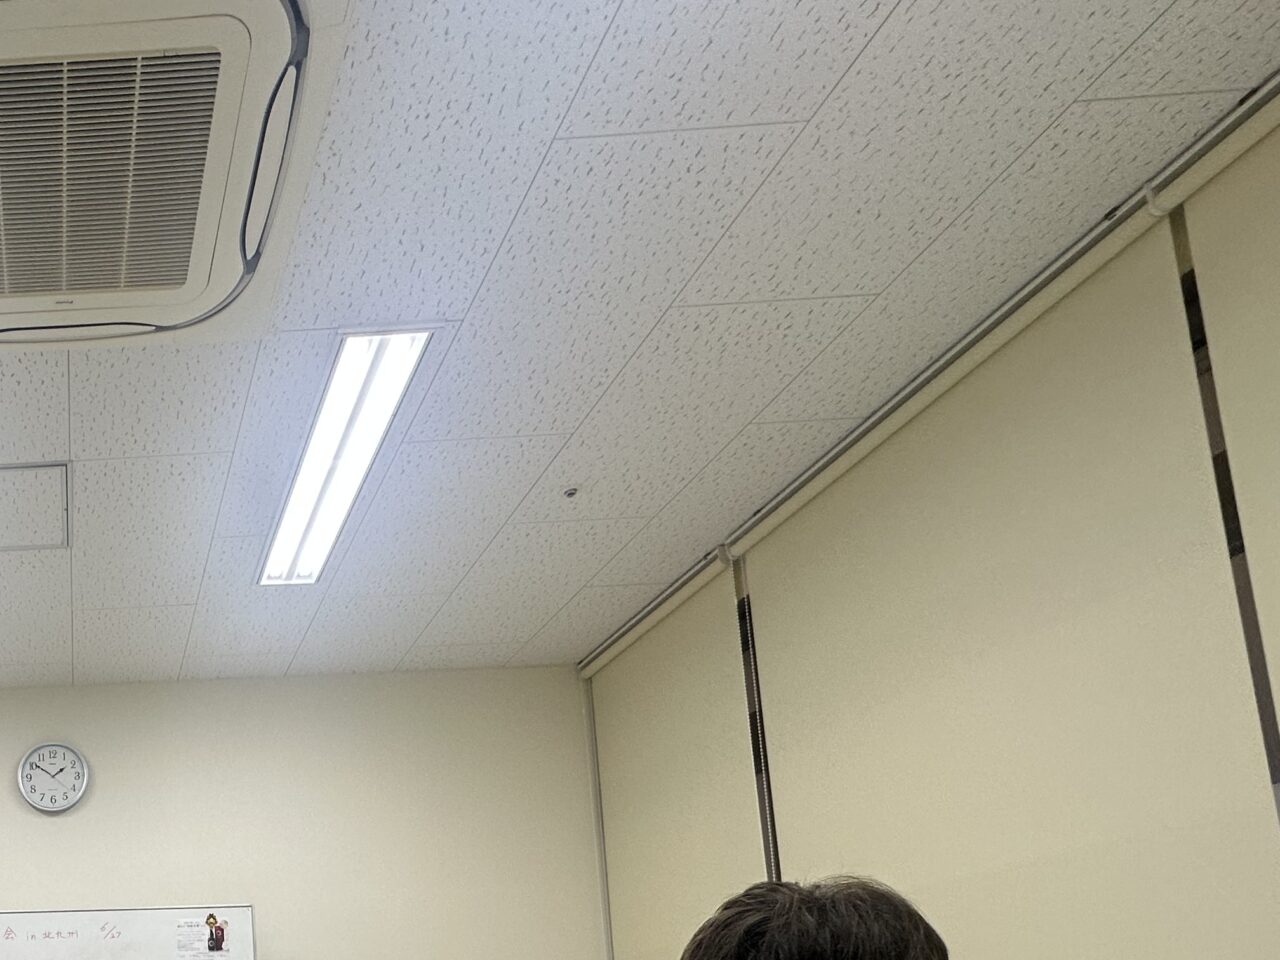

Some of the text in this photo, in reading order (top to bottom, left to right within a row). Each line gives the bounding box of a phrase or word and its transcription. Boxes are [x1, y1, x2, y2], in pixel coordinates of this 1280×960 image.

[38, 753, 45, 762] 11
[48, 750, 57, 759] 12
[29, 761, 38, 771] 10
[70, 760, 76, 769] 2
[26, 773, 32, 782] 9
[74, 772, 80, 780] 3
[30, 785, 36, 793] 8
[70, 784, 76, 792] 4
[40, 793, 45, 801] 7
[50, 795, 57, 804] 6
[62, 792, 68, 801] 5
